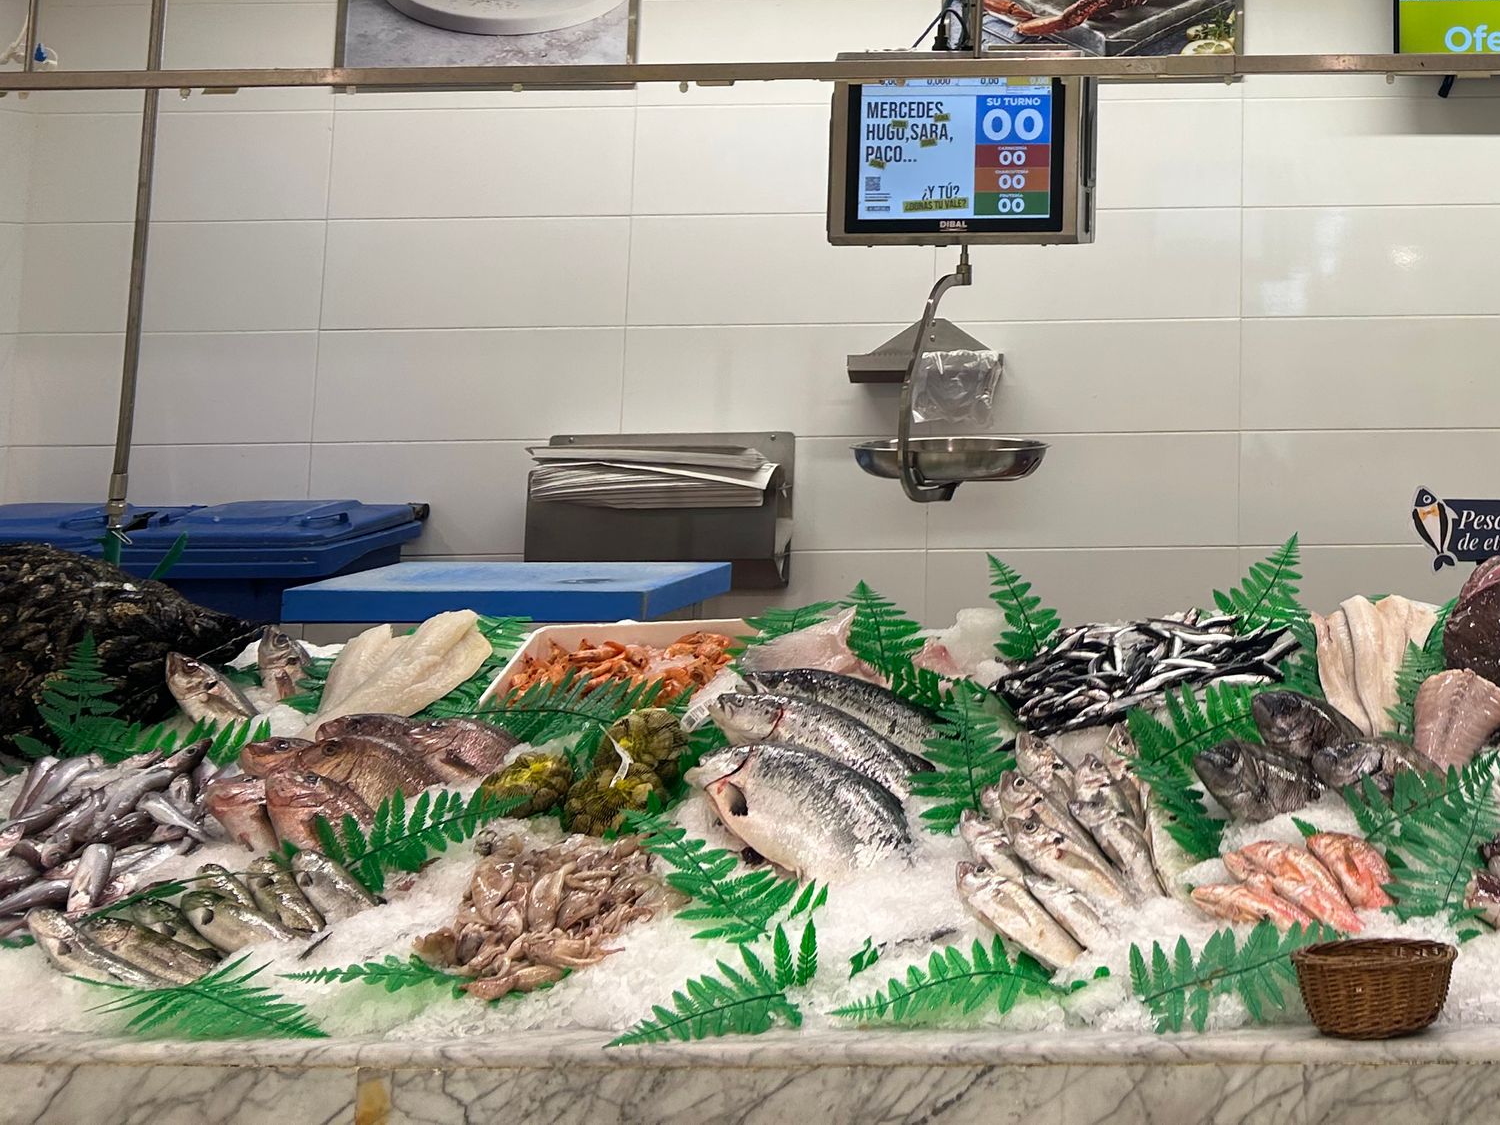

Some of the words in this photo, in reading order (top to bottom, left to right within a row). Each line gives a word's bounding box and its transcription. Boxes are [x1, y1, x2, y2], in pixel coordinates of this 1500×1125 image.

[987, 97, 1000, 106] SU
[1003, 97, 1041, 106] TURNO
[867, 101, 943, 119] MERCEDES
[982, 108, 1044, 141] 00
[999, 150, 1026, 165] 00
[998, 174, 1025, 189] 00
[938, 182, 960, 200] TÚ?
[998, 198, 1025, 213] 00
[940, 220, 968, 228] DIBAL
[1457, 532, 1478, 551] de
